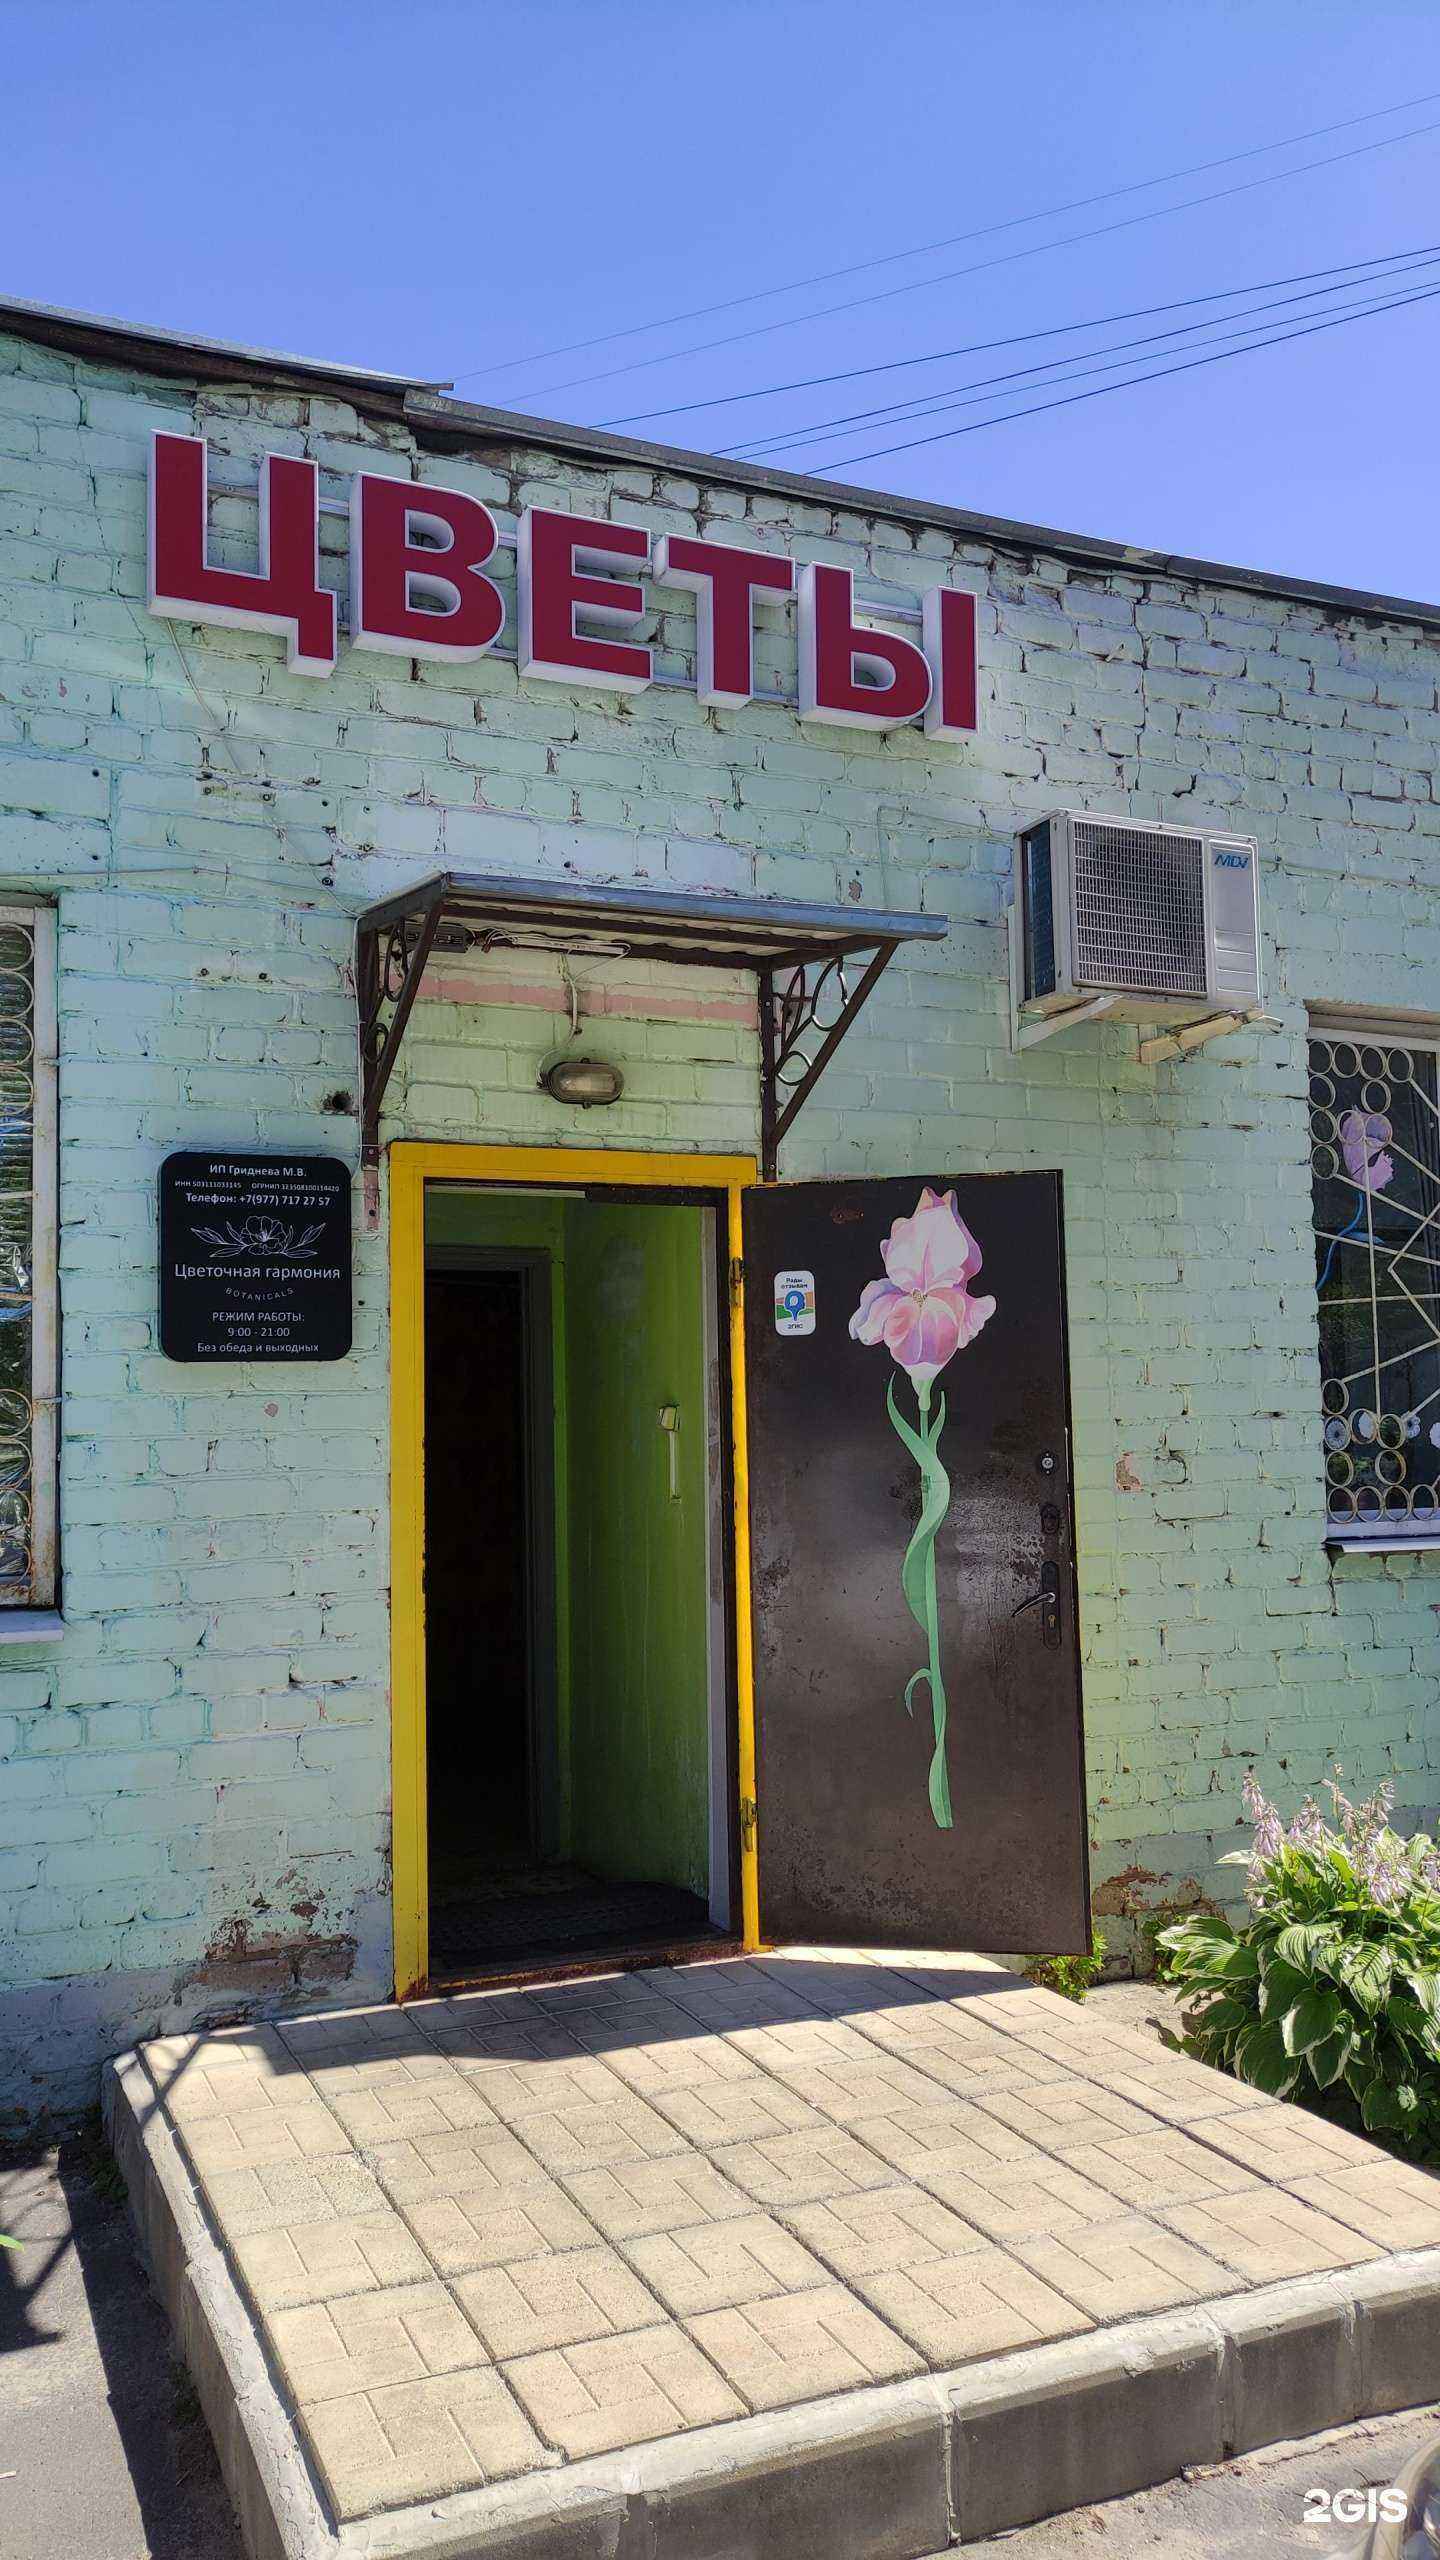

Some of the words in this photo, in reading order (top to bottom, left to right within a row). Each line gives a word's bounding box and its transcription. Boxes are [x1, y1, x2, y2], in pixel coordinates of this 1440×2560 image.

[148, 429, 979, 742] ЦВЕТЫ
[1214, 854, 1249, 868] MDV
[209, 1164, 226, 1174] ИП
[229, 1165, 280, 1176] Гриднева
[283, 1168, 307, 1177] М.В.
[186, 1193, 237, 1205] Телефон:
[240, 1194, 279, 1206] +7(977)
[282, 1196, 300, 1205] 717
[303, 1196, 316, 1206] 27
[318, 1197, 331, 1206] 57
[174, 1264, 261, 1280] Цветочная
[266, 1267, 341, 1281] гармония
[225, 1287, 294, 1301] BOTANICALS
[212, 1312, 255, 1322] РЕЖИМ
[258, 1312, 305, 1322] РАБОТЫ:
[227, 1328, 251, 1337] 9:00
[261, 1328, 290, 1337] 21:00
[197, 1343, 217, 1352] Без
[219, 1343, 252, 1354] обеда
[265, 1345, 319, 1354] выходных
